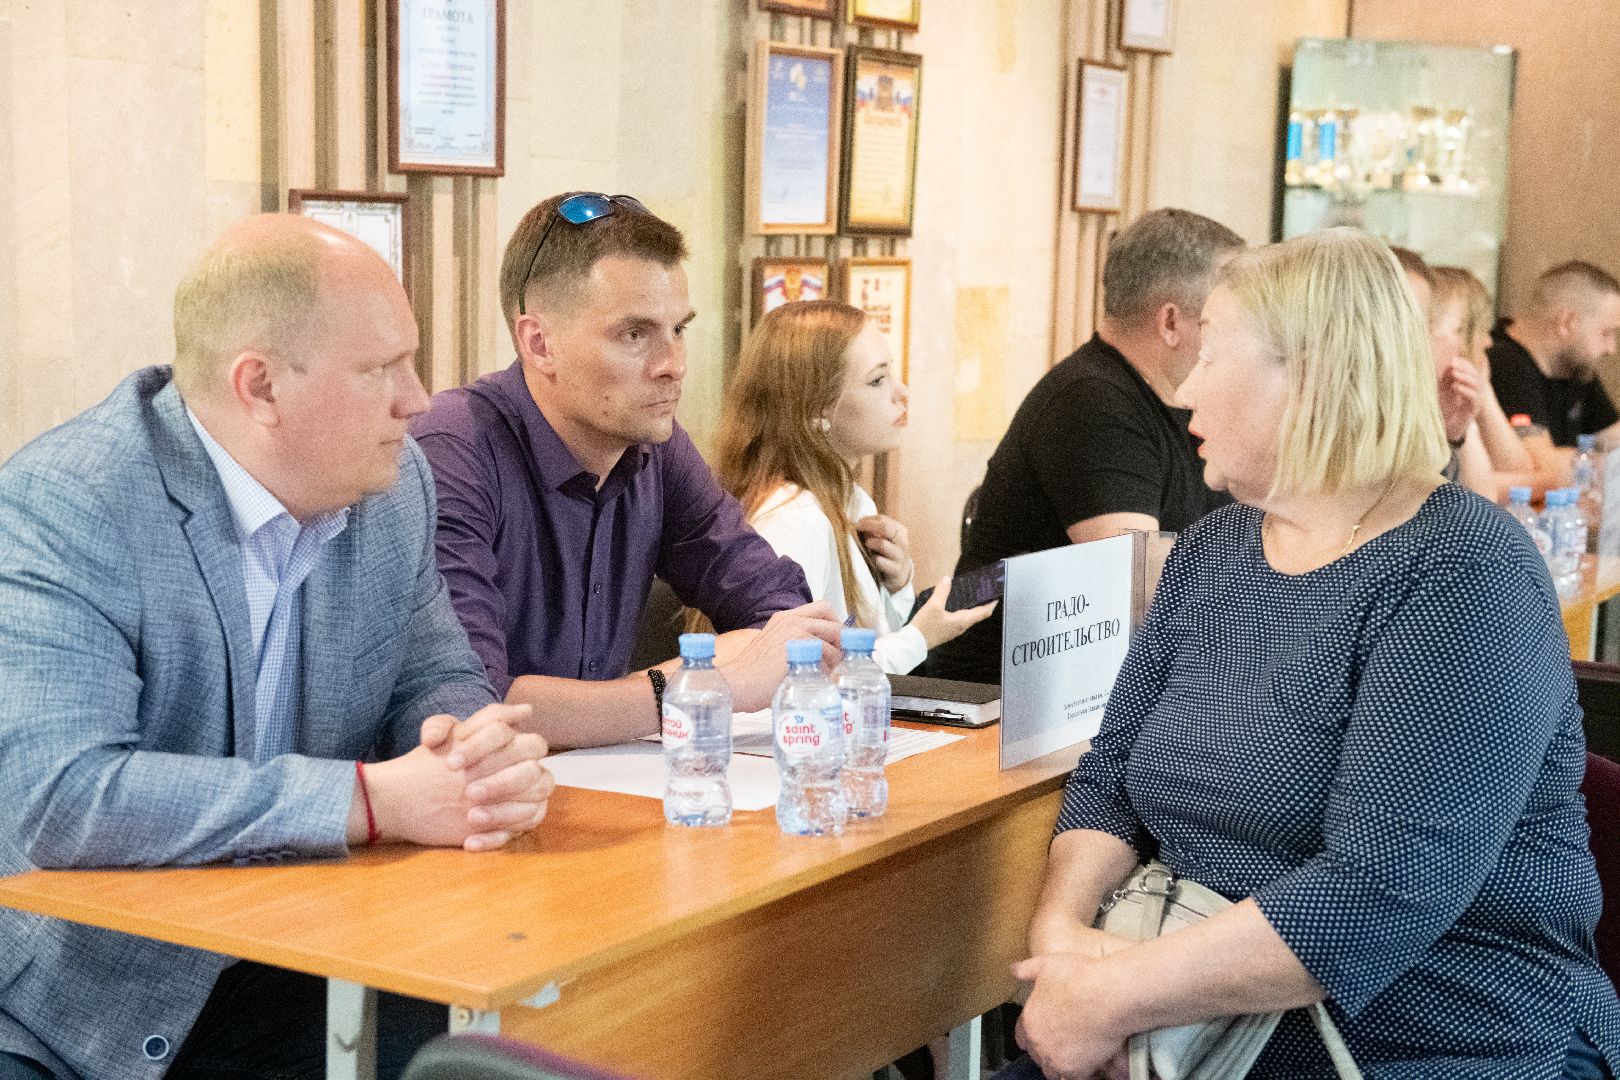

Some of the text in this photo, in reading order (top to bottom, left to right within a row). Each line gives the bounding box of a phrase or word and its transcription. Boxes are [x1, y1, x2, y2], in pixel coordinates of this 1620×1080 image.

[421, 7, 474, 24] ГРАМОТА
[1047, 594, 1090, 622] ГРАДО-
[1012, 618, 1120, 666] СТРОИТЕЛЬСТВО
[785, 723, 816, 734] saint
[783, 734, 821, 746] spring
